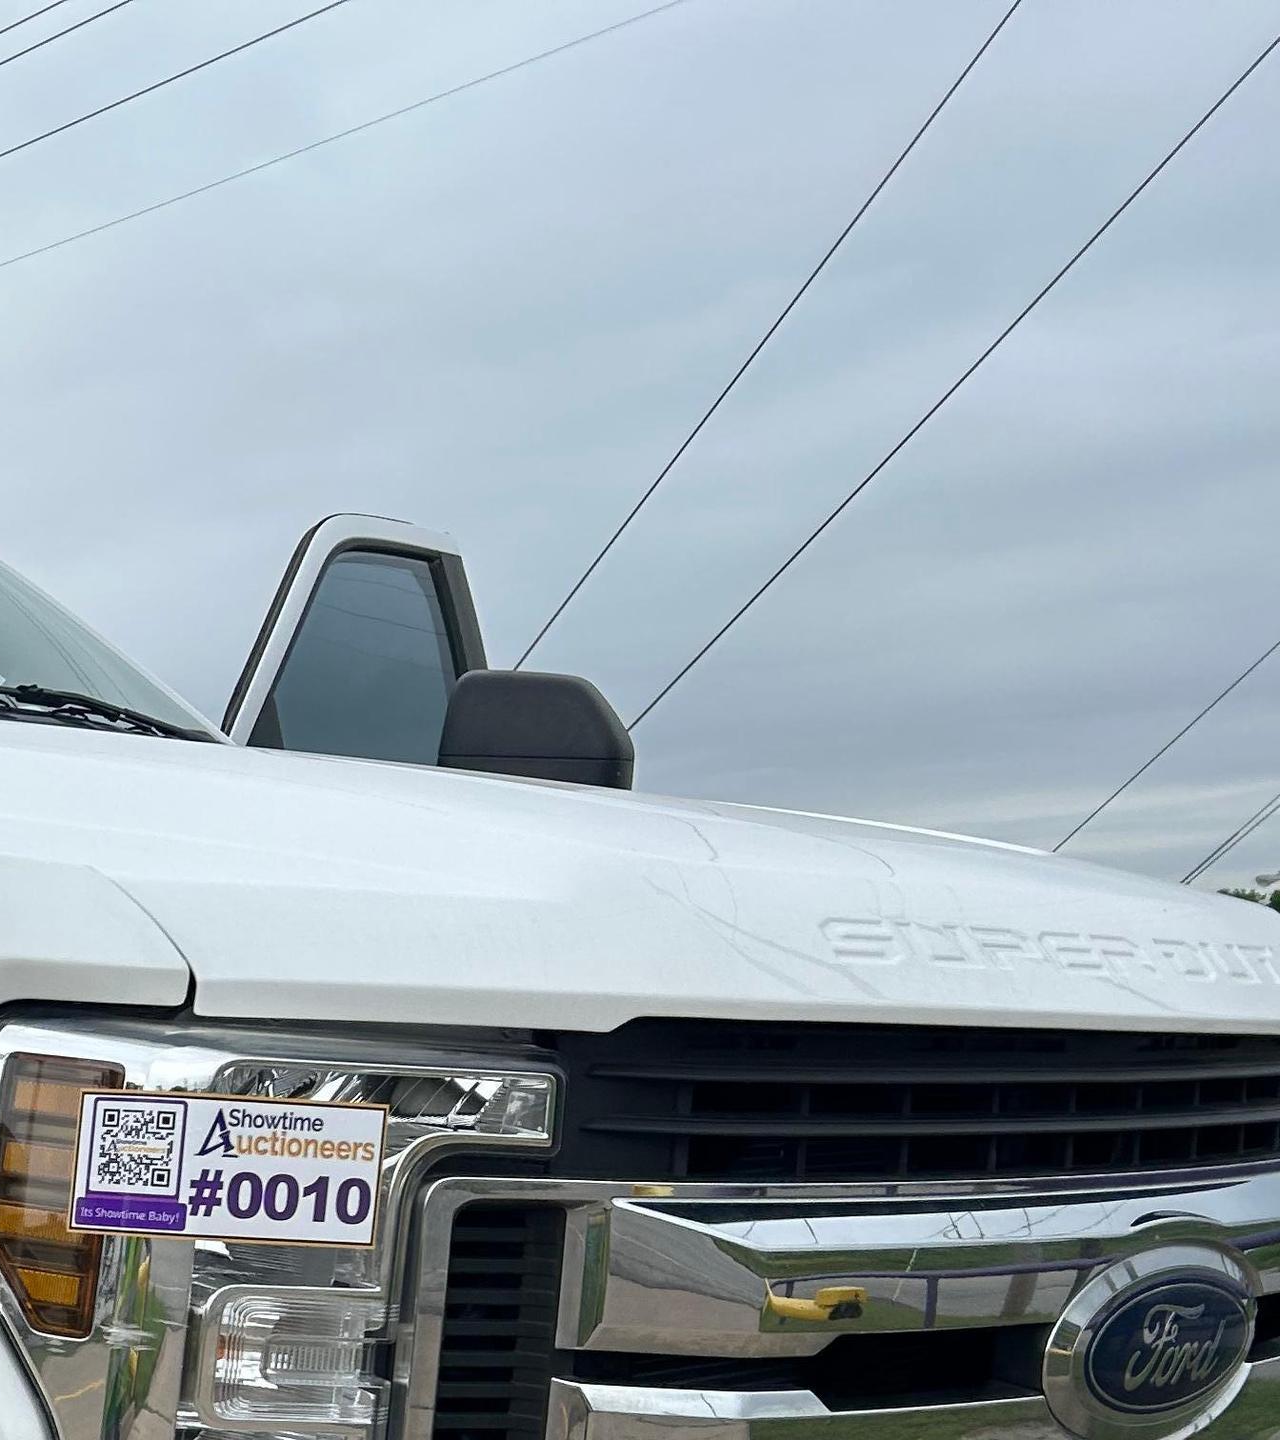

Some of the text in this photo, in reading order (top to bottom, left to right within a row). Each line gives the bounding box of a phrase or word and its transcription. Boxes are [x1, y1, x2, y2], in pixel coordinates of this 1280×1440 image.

[819, 916, 1155, 980] SUPER
[228, 1109, 325, 1132] Showtime
[94, 1207, 146, 1221] Showtime
[148, 1211, 180, 1225] Baby!
[189, 1168, 372, 1225] #0010
[1123, 1303, 1227, 1392] Ford
